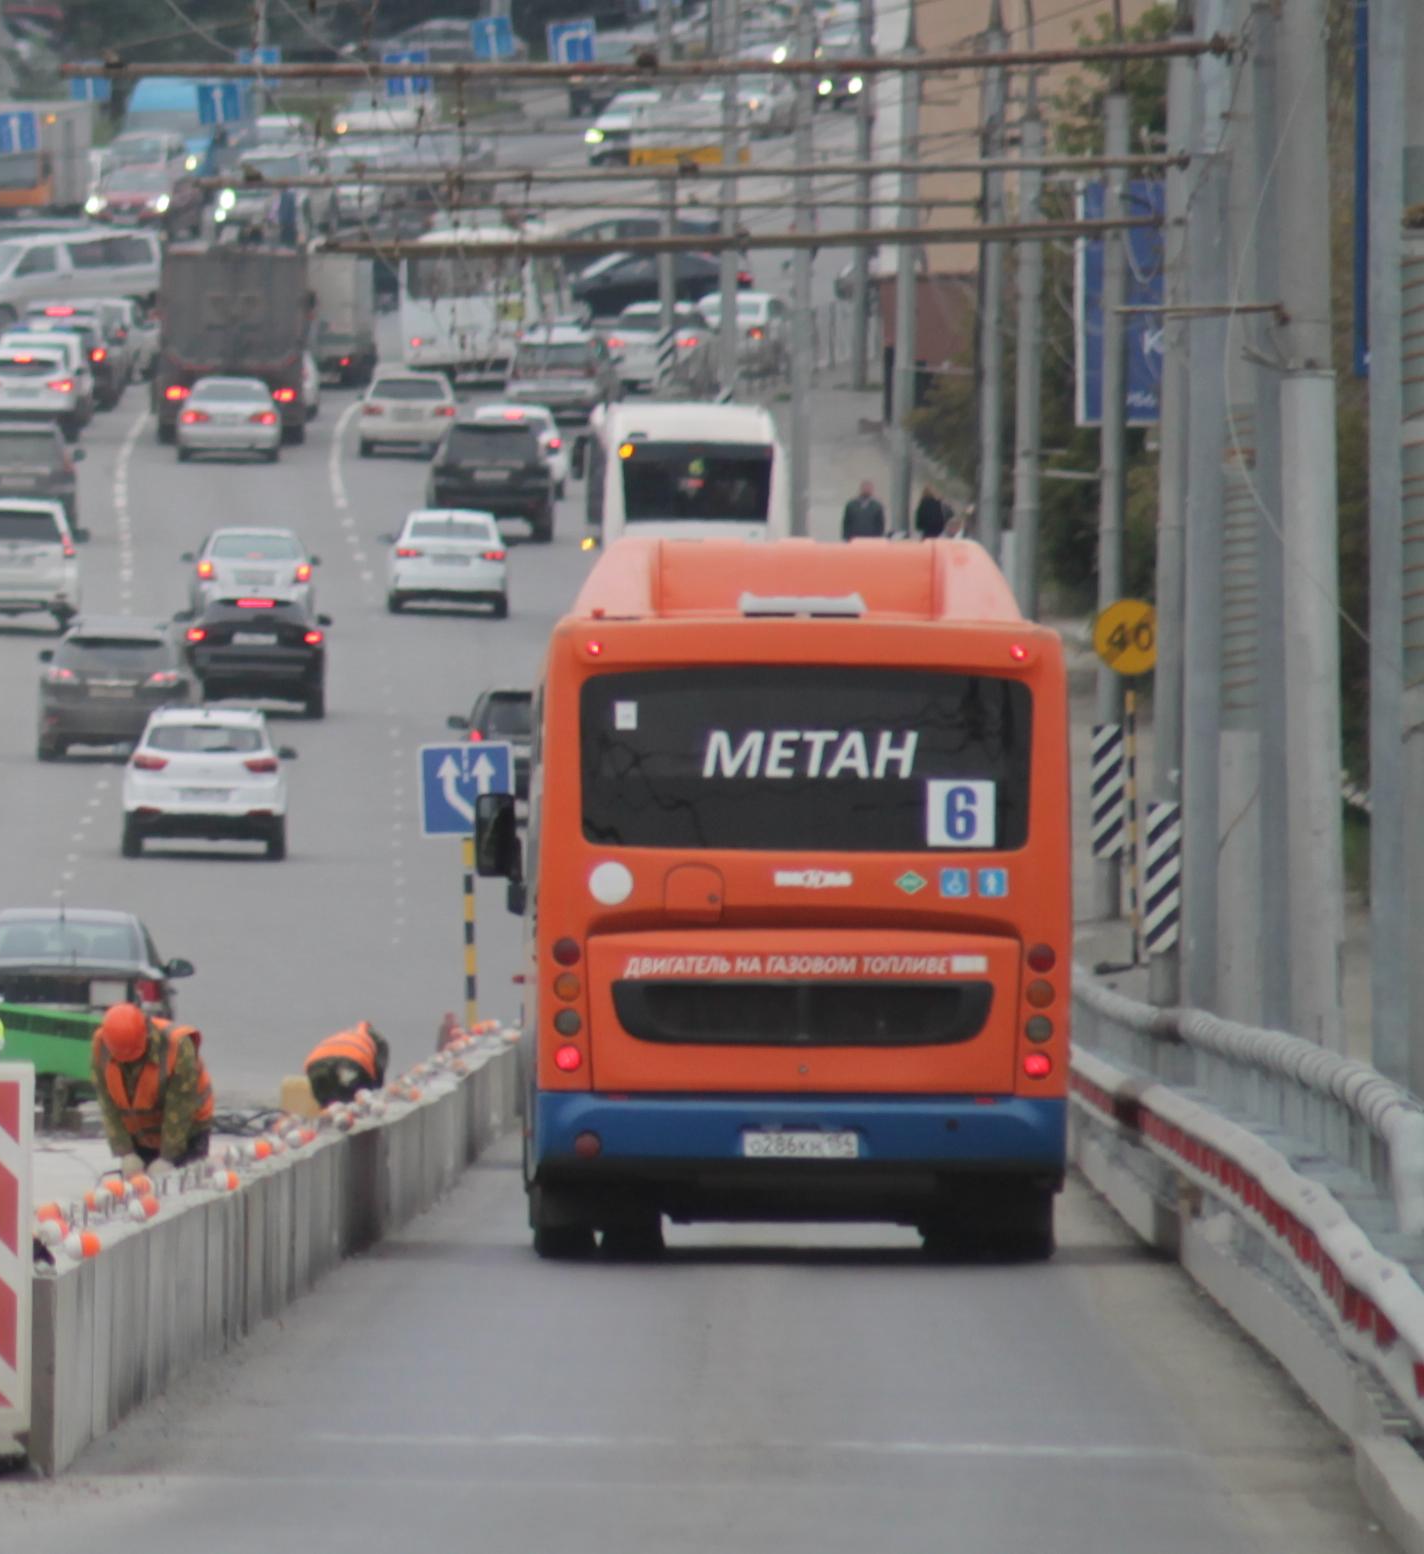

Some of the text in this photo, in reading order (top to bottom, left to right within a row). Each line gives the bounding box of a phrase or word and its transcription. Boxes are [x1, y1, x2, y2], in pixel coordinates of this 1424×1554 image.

[1106, 622, 1154, 653] 40
[702, 730, 919, 780] МЕТАН
[944, 786, 978, 841] 6
[624, 956, 950, 978] ДВИГАТЕЛЬ НА ГАЗОВОМ ТОПЛИВЕ
